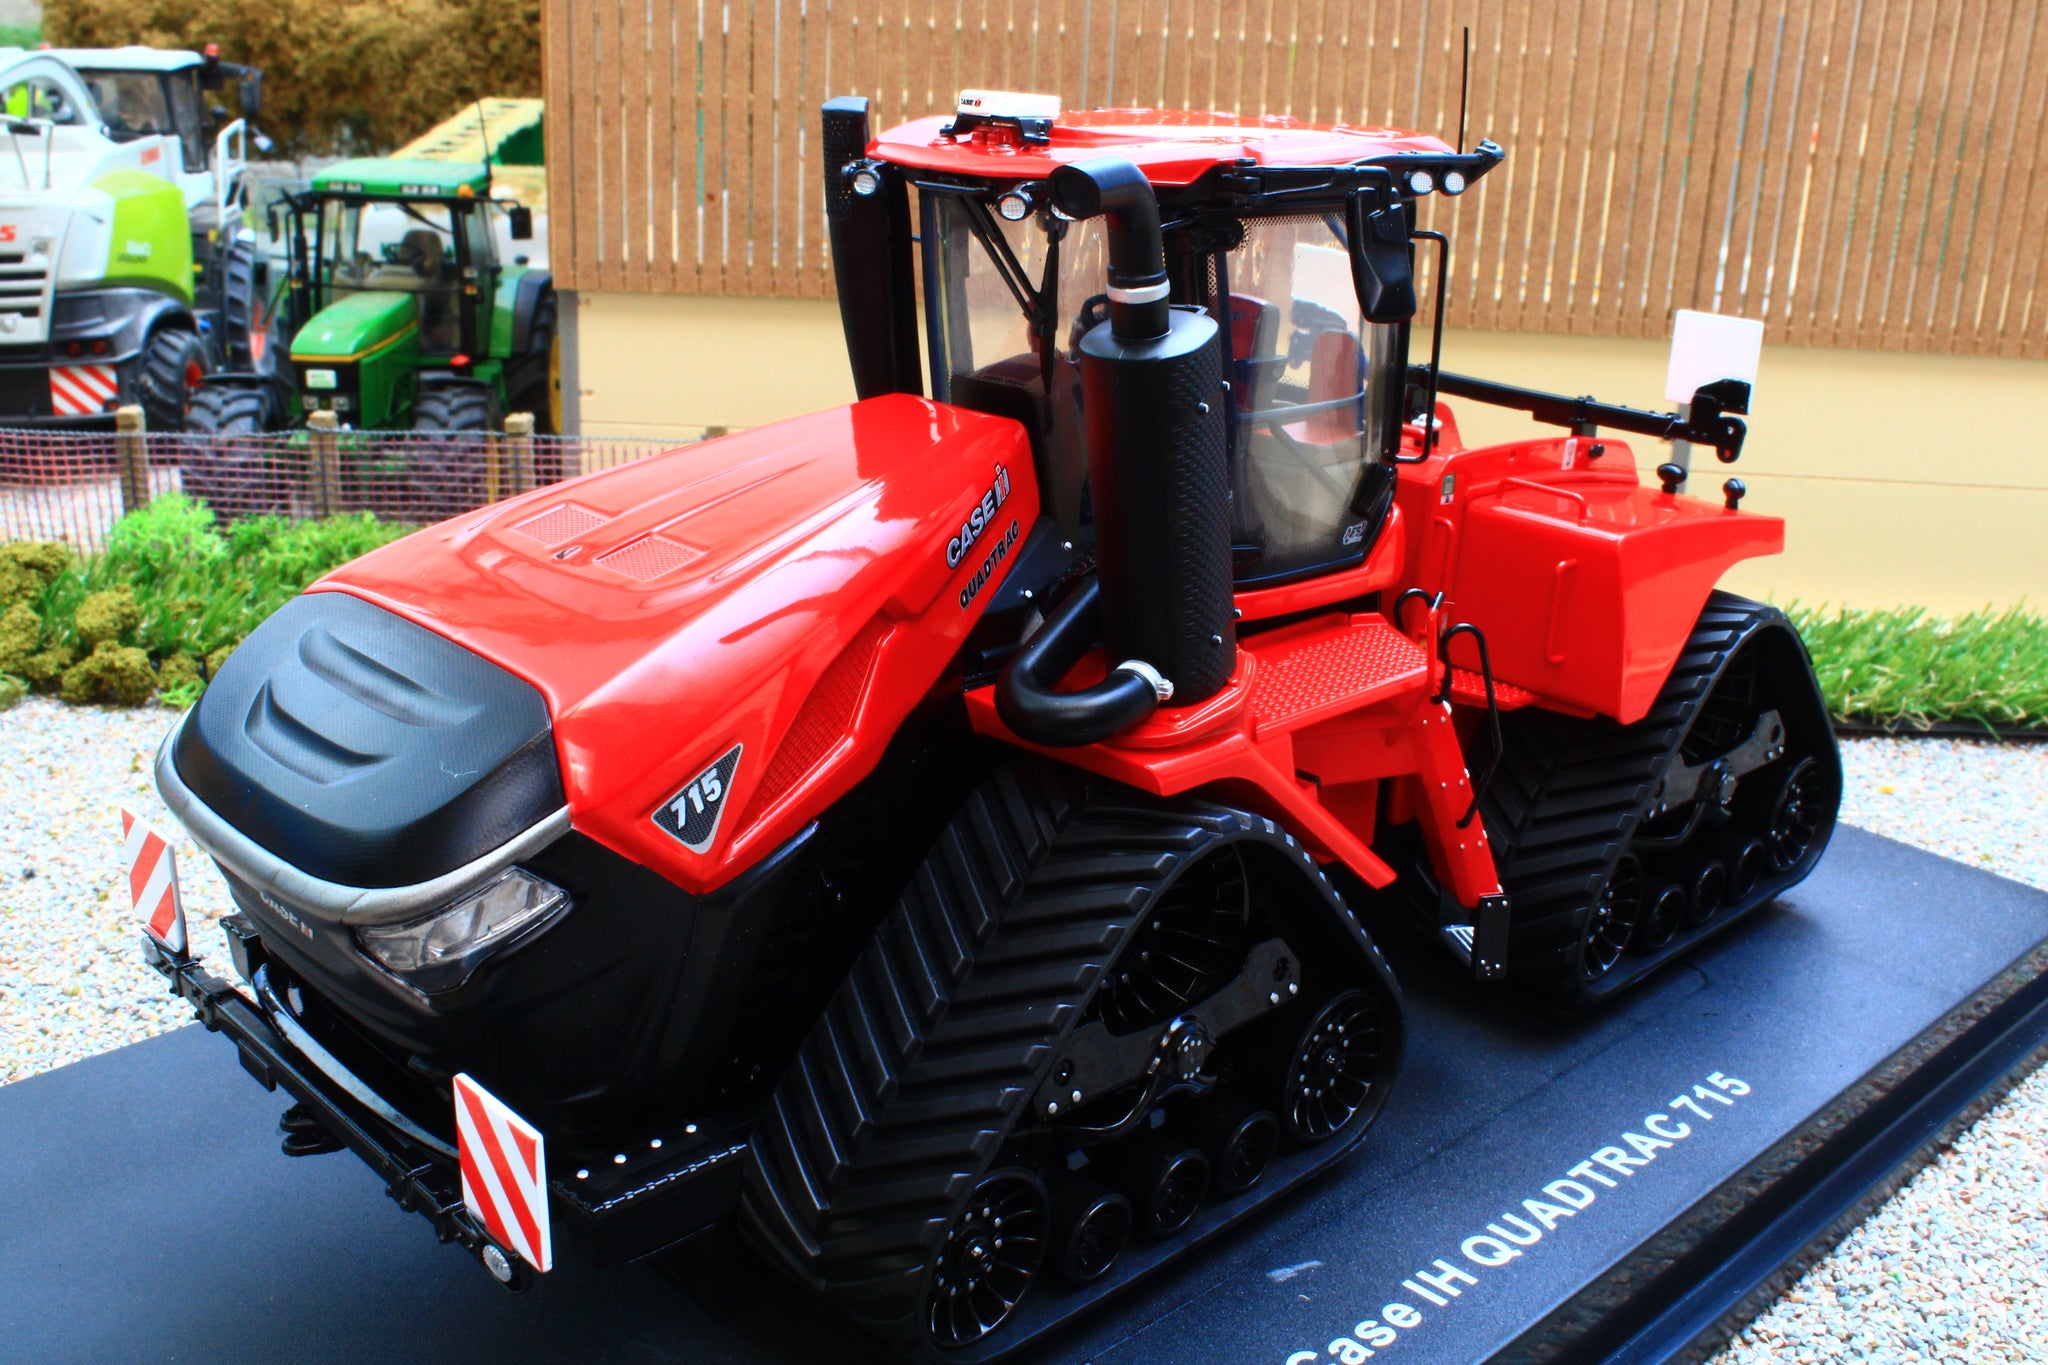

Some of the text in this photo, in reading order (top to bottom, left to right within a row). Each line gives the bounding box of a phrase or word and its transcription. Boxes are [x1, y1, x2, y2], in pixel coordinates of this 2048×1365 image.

[945, 490, 996, 569] CASE
[959, 519, 1020, 609] QUADTRAC
[669, 767, 723, 829] 715
[1401, 1258, 1479, 1307] IH
[1460, 1112, 1691, 1266] QUADTRAC
[1668, 1071, 1752, 1120] 715
